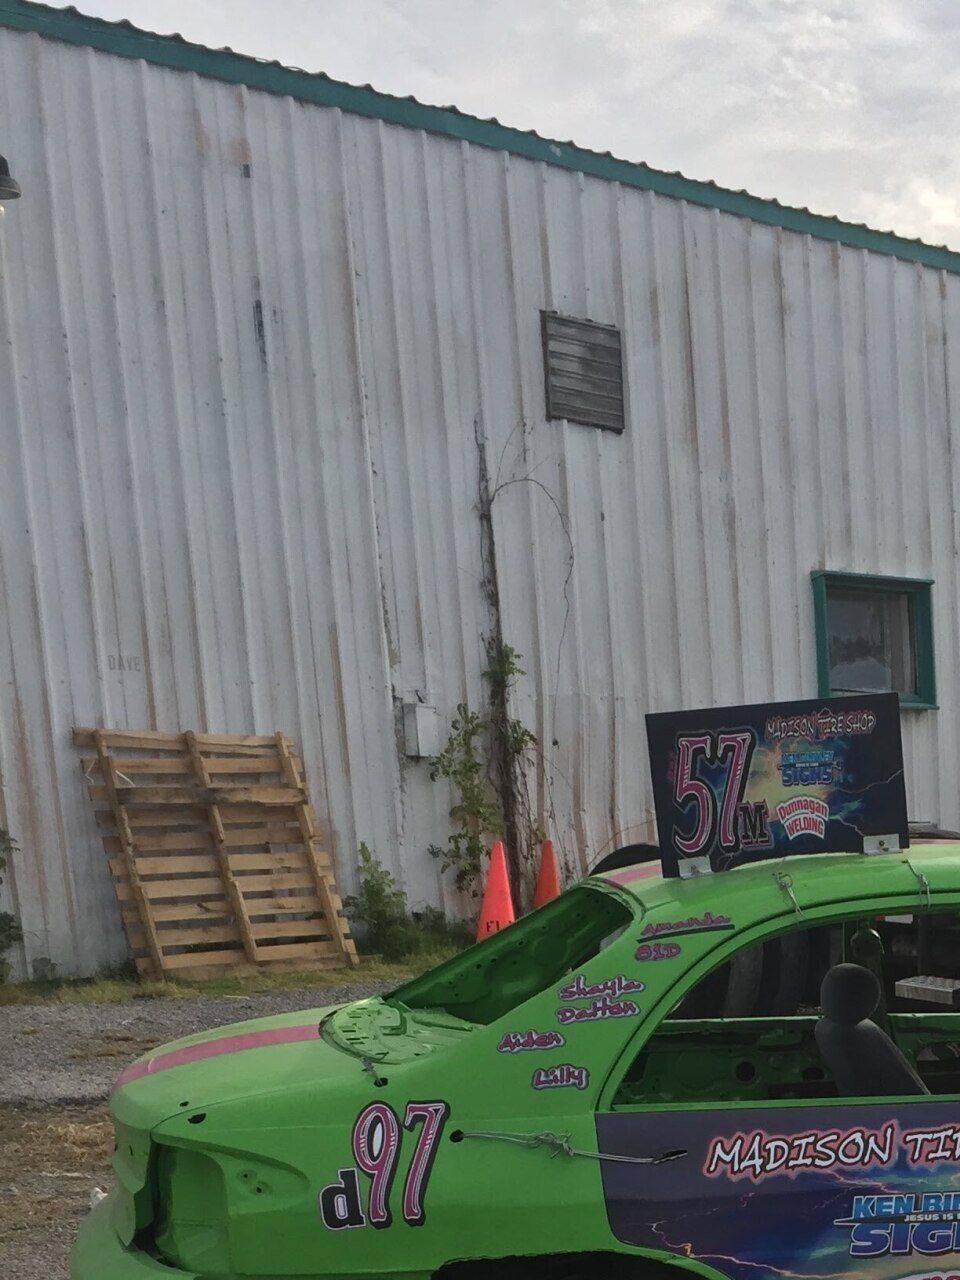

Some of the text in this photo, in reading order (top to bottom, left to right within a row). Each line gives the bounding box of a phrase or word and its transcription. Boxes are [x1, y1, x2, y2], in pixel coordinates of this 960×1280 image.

[108, 654, 141, 672] DAVE
[846, 712, 875, 733] SHOP
[778, 797, 829, 821] Dunnagan
[785, 815, 825, 837] WELDING
[499, 1030, 563, 1051] Aiden
[707, 1124, 895, 1176] MADISON
[852, 1194, 915, 1220] KEN
[904, 1212, 940, 1222] JESUS
[942, 1212, 954, 1220] IS
